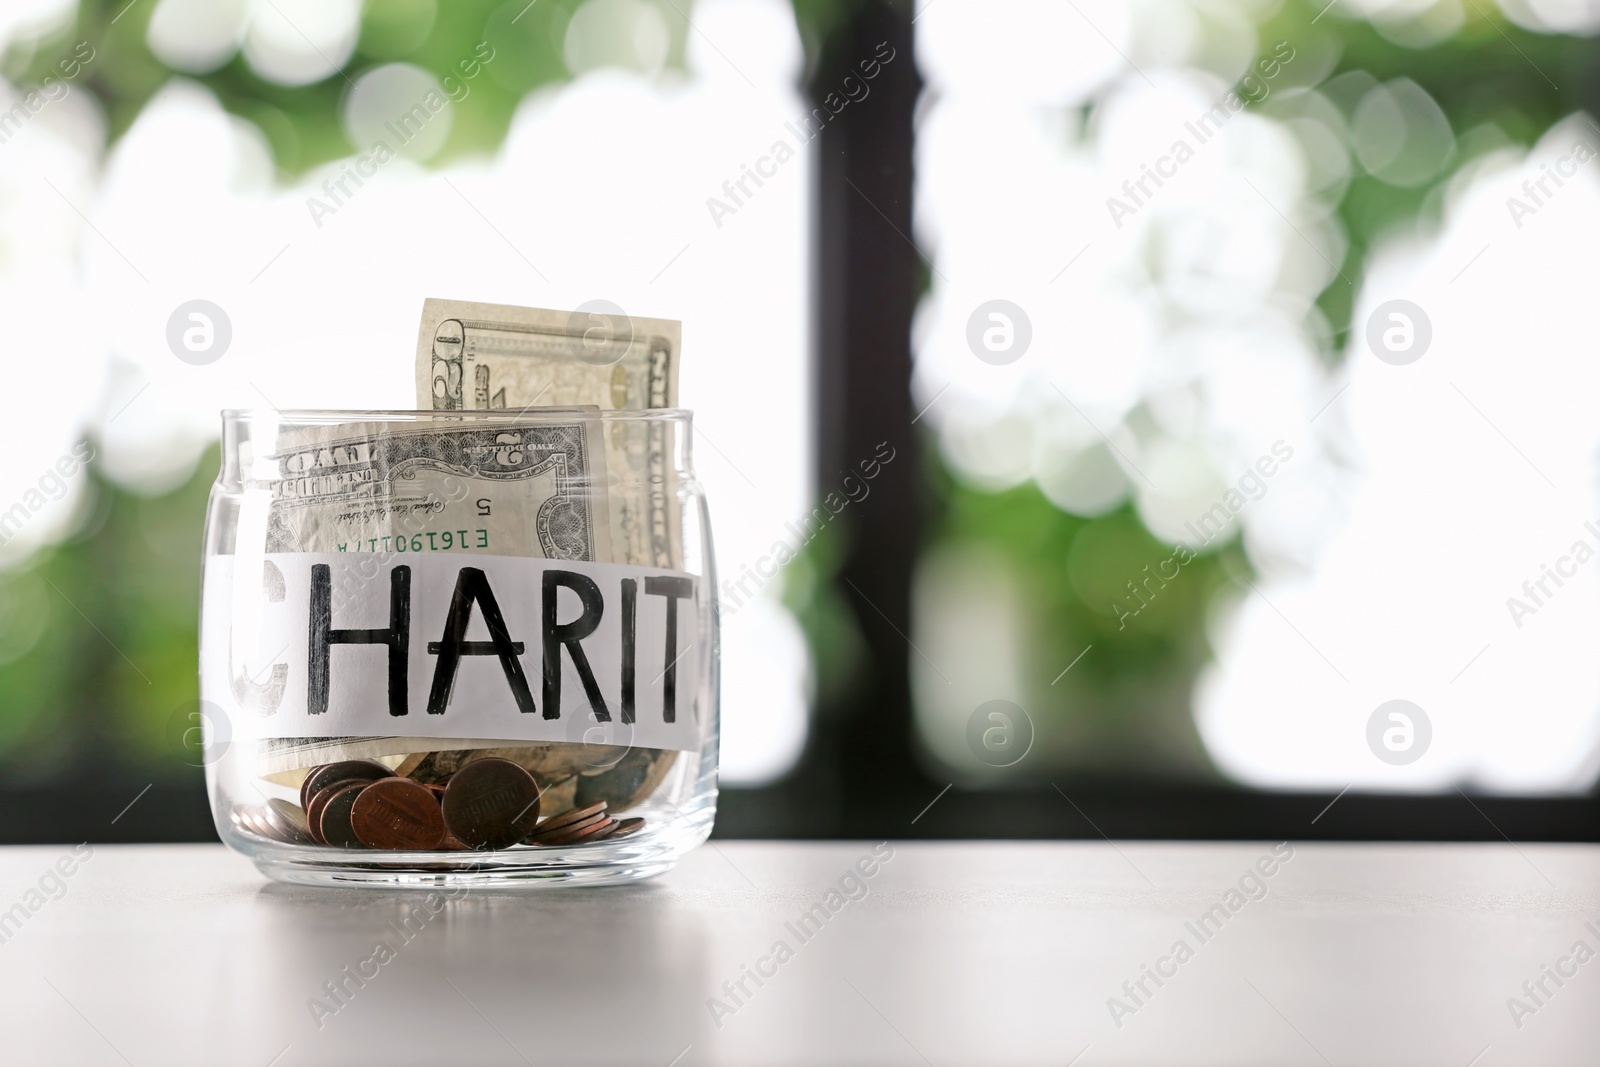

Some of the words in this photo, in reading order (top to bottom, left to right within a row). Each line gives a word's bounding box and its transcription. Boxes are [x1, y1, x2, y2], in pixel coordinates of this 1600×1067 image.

[527, 443, 555, 451] TWO
[476, 498, 491, 516] 5
[229, 560, 698, 724] CHARIT
